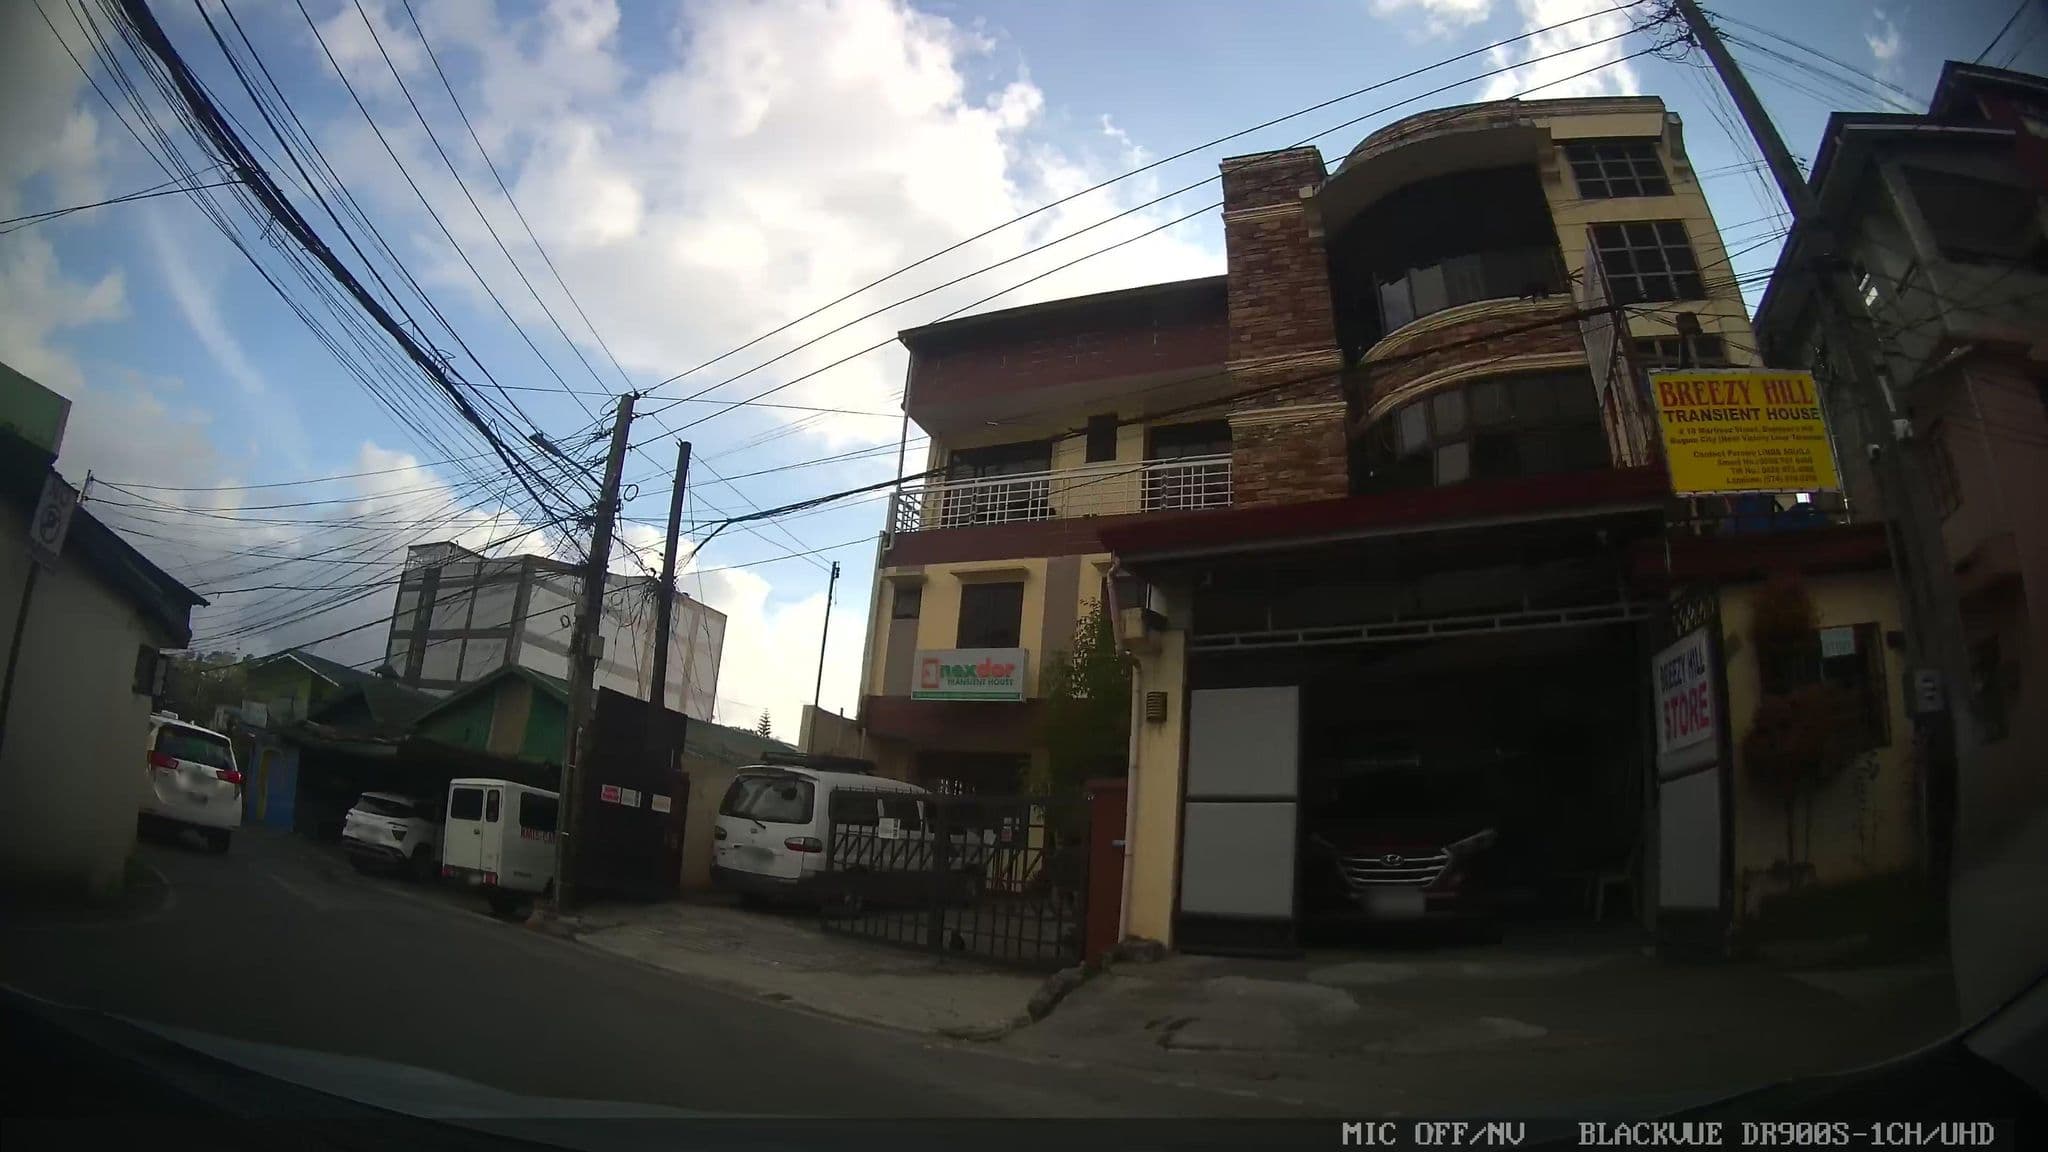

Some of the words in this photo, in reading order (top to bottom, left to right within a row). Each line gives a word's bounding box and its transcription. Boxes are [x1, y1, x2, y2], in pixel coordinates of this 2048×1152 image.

[1658, 379, 1753, 407] BREEZY
[1762, 379, 1814, 405] HILL
[1663, 408, 1761, 423] TRANSIENT
[1767, 407, 1822, 420] HOUSE
[1687, 645, 1705, 680] HILL
[947, 678, 986, 687] TRANSIENT
[988, 678, 1014, 687] HOUSE
[1664, 681, 1710, 743] STORE
